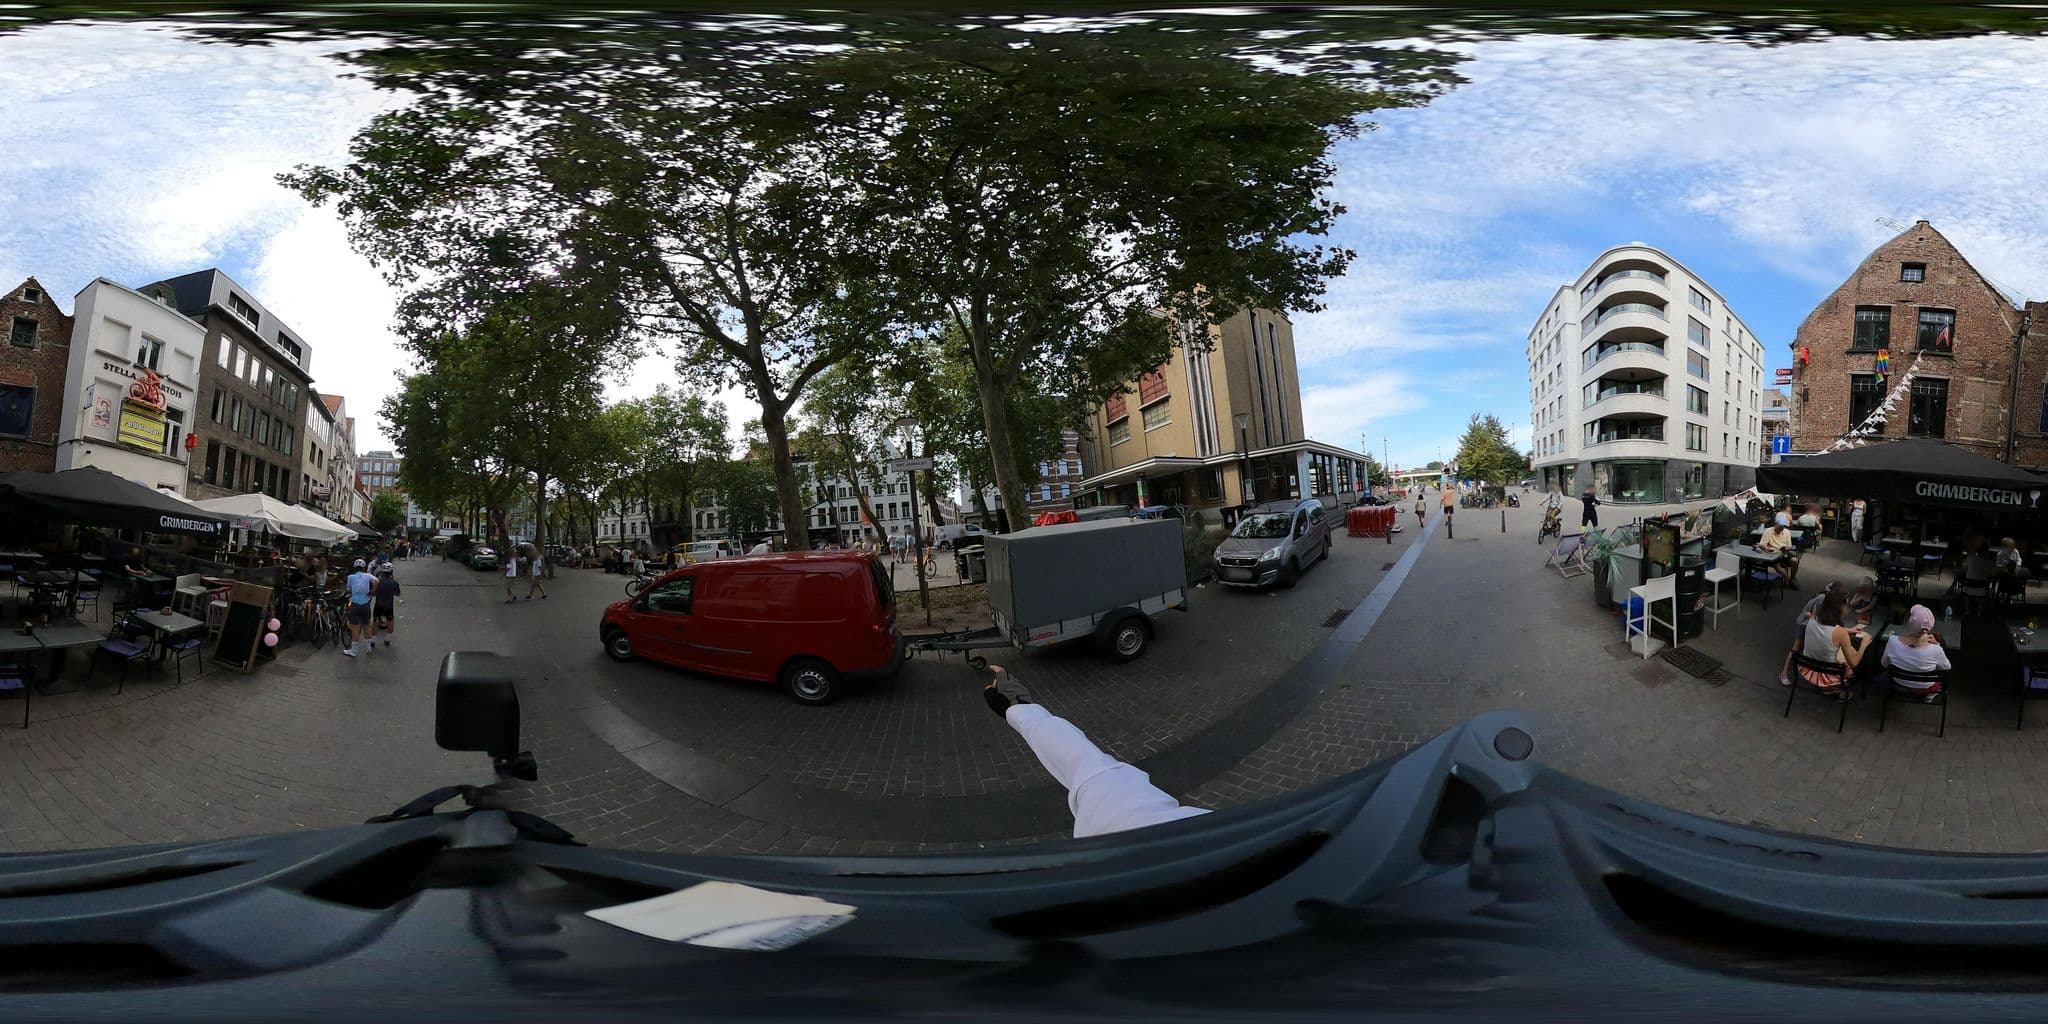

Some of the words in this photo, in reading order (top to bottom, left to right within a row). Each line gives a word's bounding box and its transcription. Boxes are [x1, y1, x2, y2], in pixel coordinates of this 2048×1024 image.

[103, 362, 137, 380] STELLA
[157, 383, 182, 399] RTOIS
[1915, 481, 2023, 505] GRIMBERGEN
[160, 515, 214, 532] GRIMBERGEN
